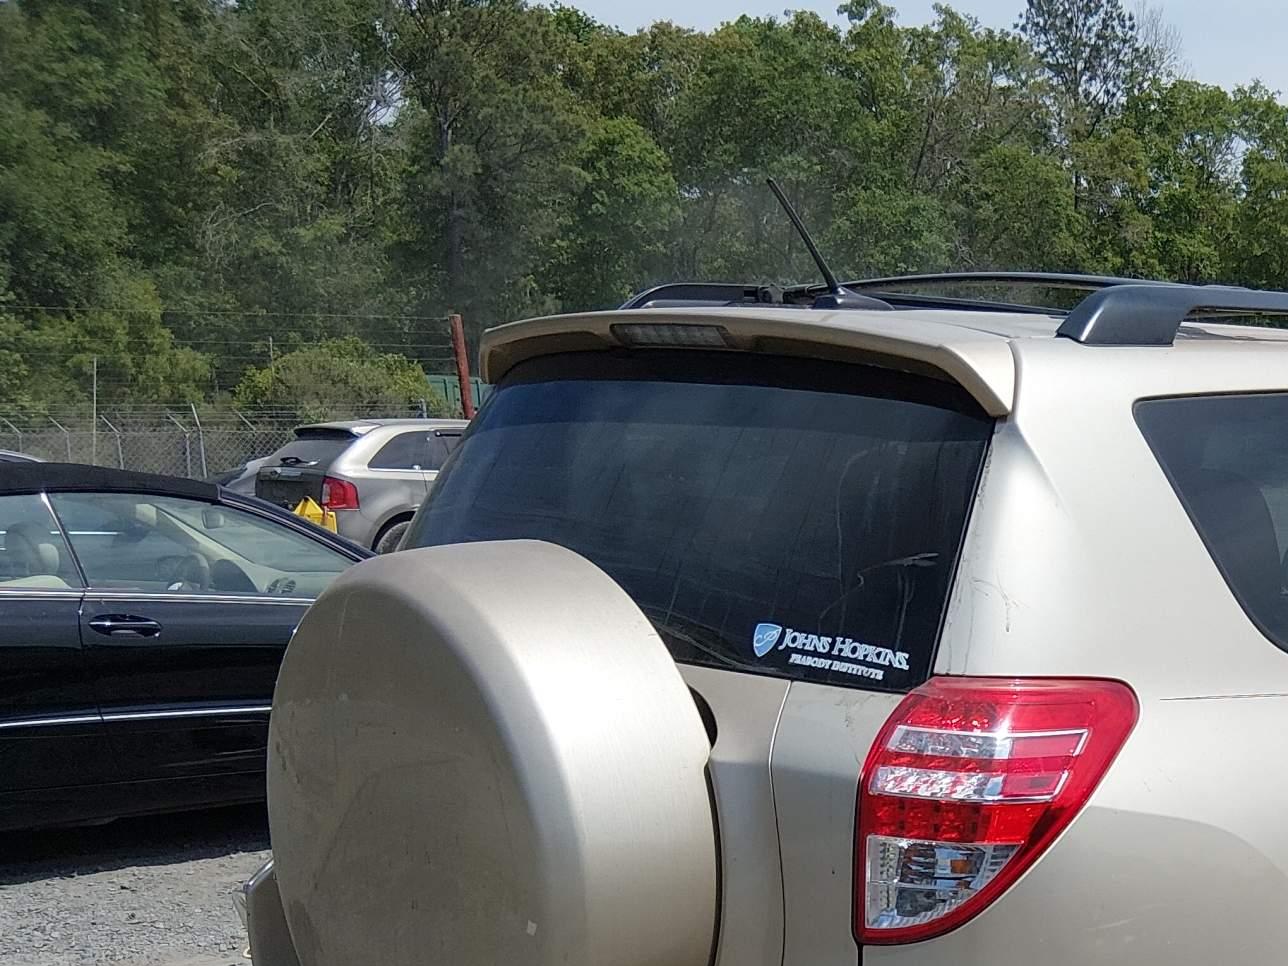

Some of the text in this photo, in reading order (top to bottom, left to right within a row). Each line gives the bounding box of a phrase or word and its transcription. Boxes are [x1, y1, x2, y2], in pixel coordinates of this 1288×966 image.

[778, 628, 909, 670] JOHNS HOPKINS
[789, 653, 884, 680] PEABODY INSTITUTE
